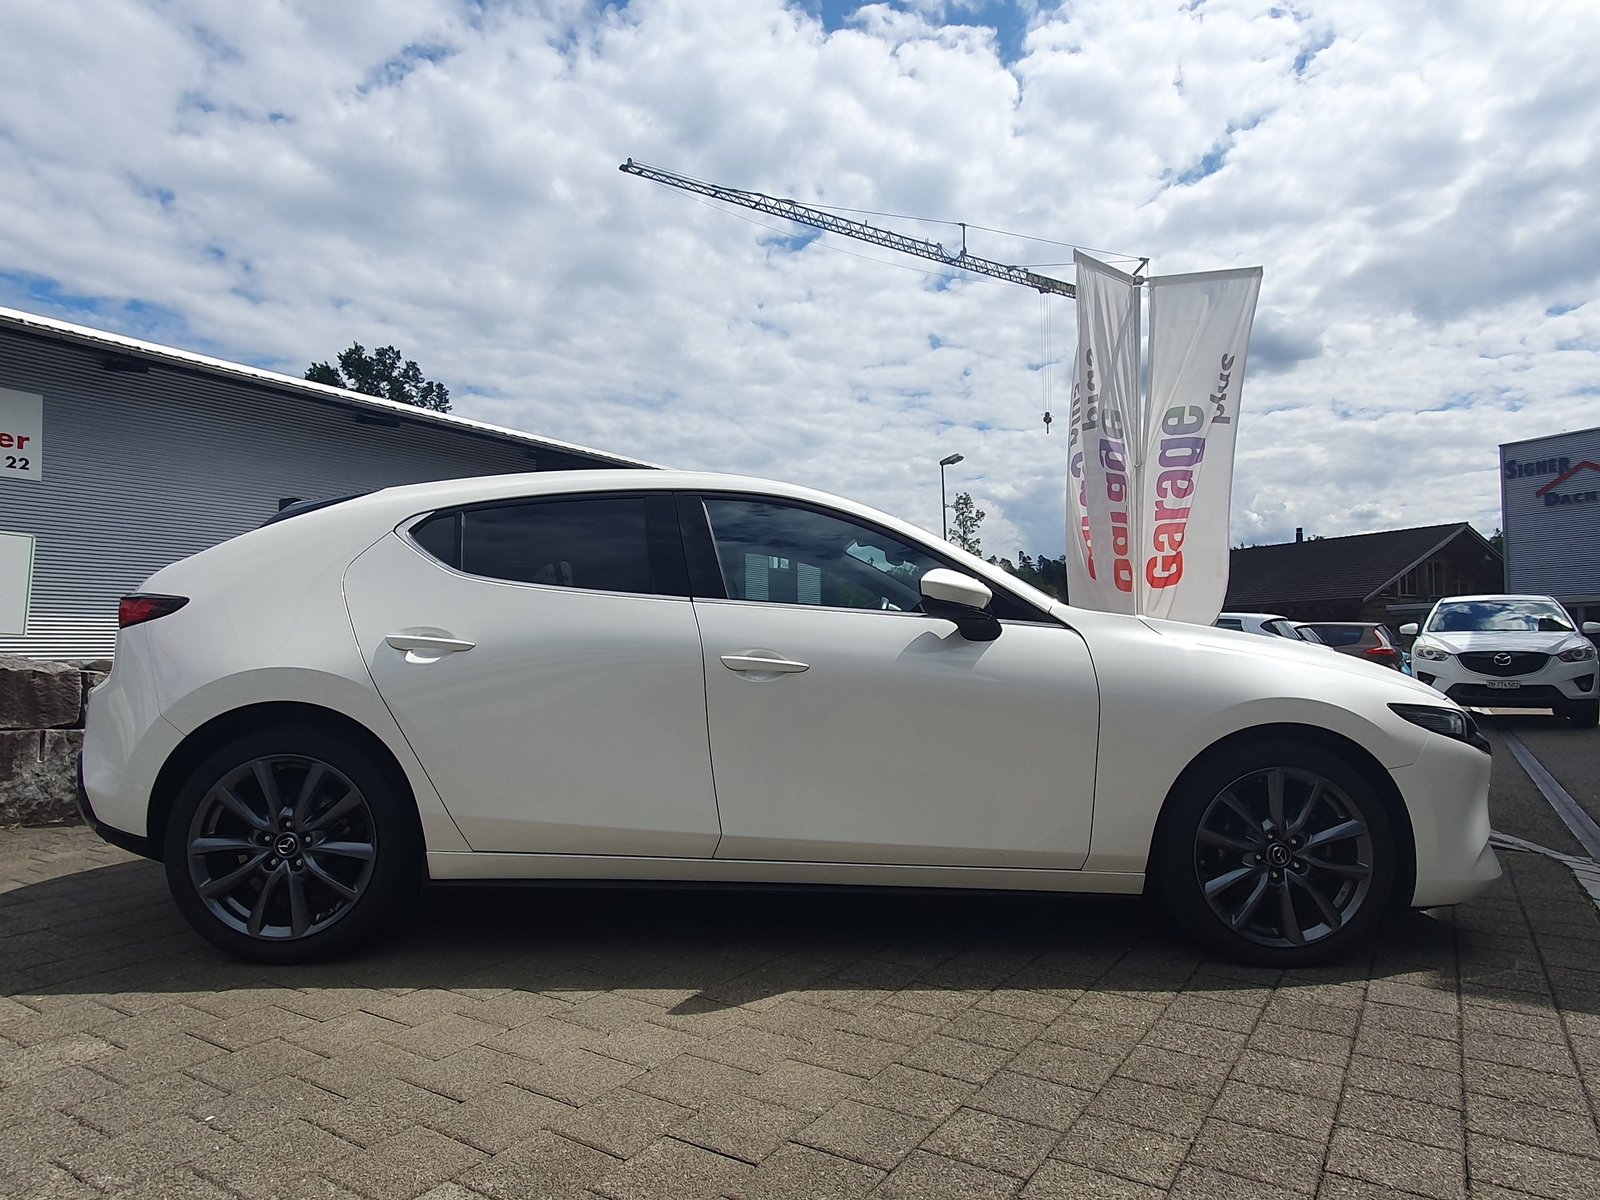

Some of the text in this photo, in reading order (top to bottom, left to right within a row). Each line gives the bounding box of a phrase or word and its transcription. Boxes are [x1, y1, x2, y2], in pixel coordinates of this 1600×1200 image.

[1210, 353, 1235, 424] plus
[5, 455, 30, 471] 22
[1146, 405, 1206, 589] Garage
